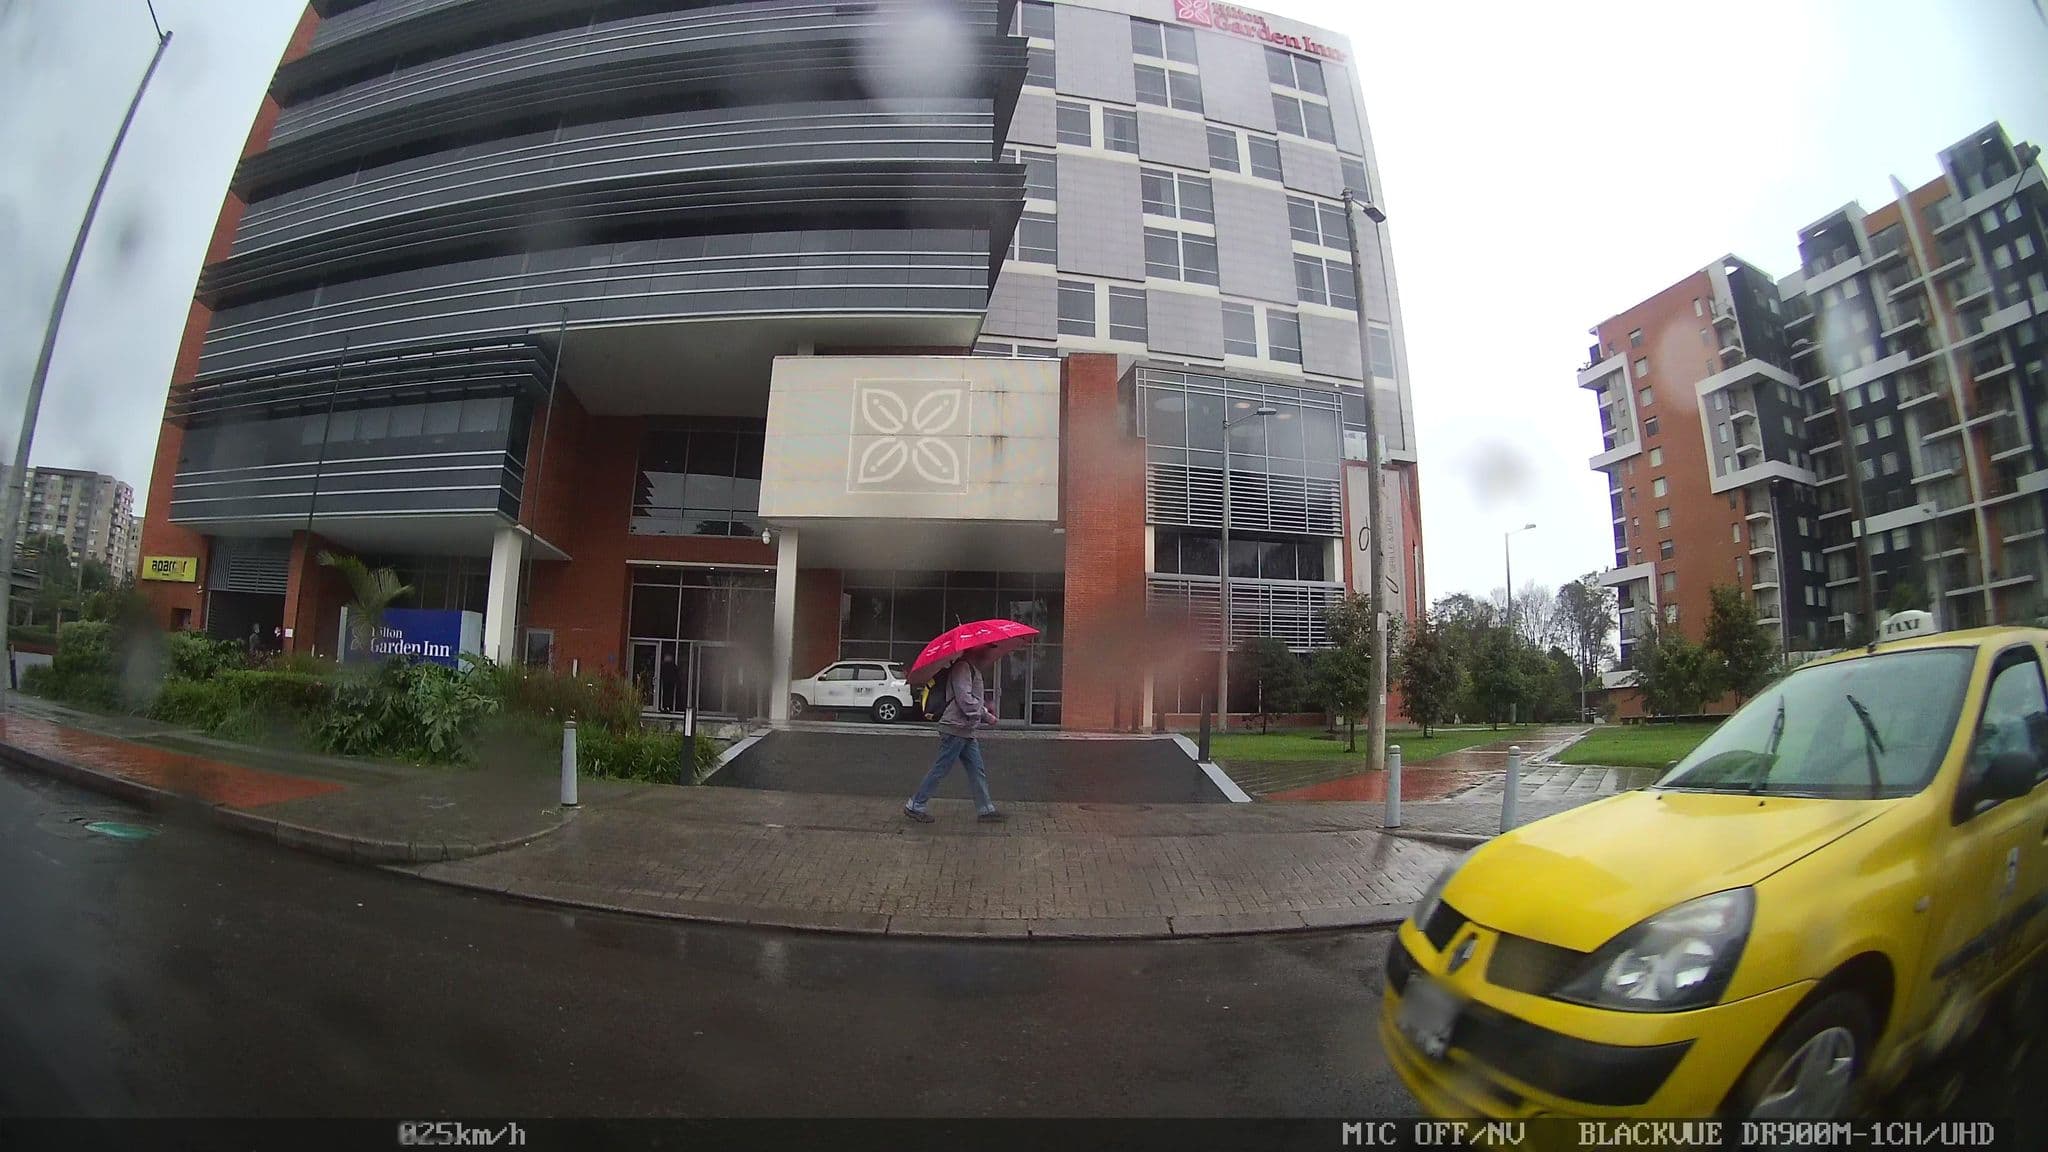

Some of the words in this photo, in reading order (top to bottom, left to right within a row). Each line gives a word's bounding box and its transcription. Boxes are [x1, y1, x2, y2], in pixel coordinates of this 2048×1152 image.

[1213, 15, 1302, 50] Garden
[1886, 618, 1921, 634] TAXI
[424, 640, 451, 657] Inn
